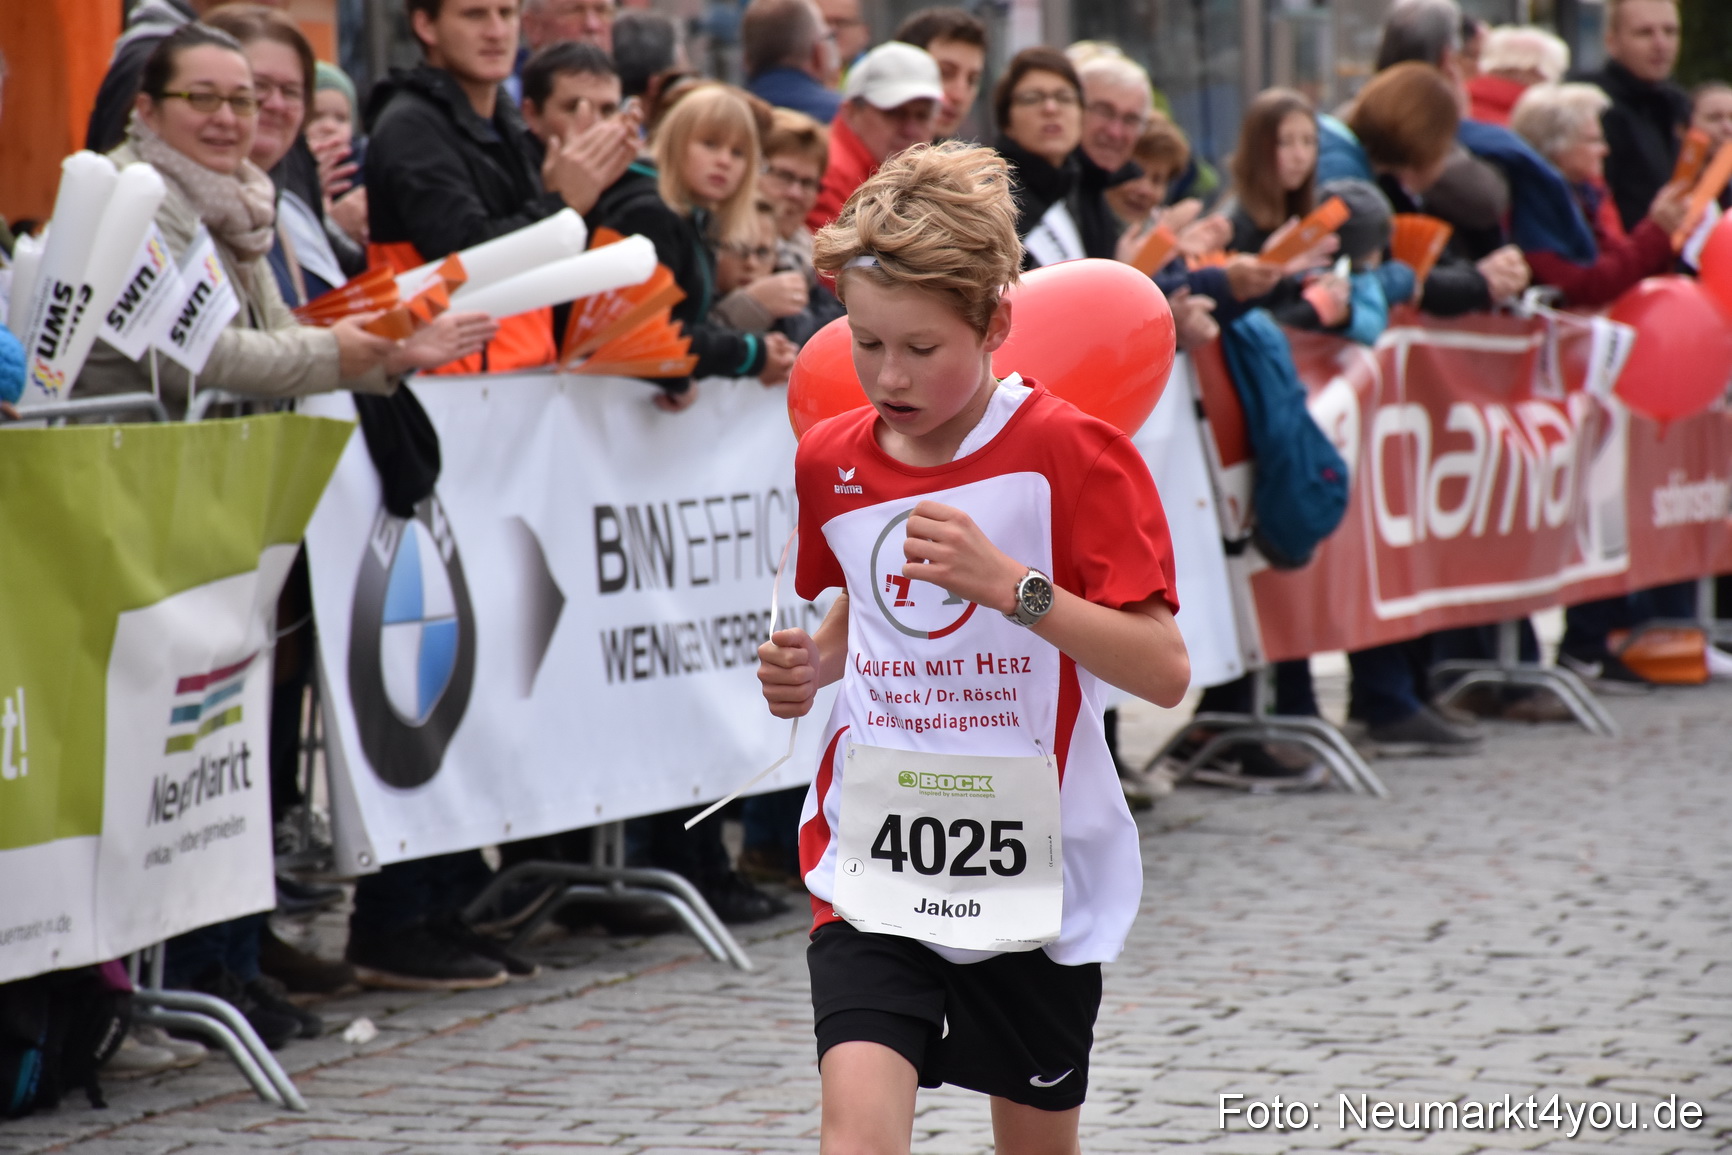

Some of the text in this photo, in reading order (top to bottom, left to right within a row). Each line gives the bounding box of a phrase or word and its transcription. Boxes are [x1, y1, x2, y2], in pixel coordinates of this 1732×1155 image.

[834, 483, 863, 494] erima
[601, 620, 700, 686] WENIG
[885, 689, 921, 704] Heck
[924, 688, 932, 705] /
[937, 689, 960, 702] Dr.
[963, 687, 1017, 702] Röschl
[919, 772, 994, 792] BOCK
[870, 813, 1028, 877] 4025
[849, 863, 858, 873] J
[913, 898, 981, 918] Jakob
